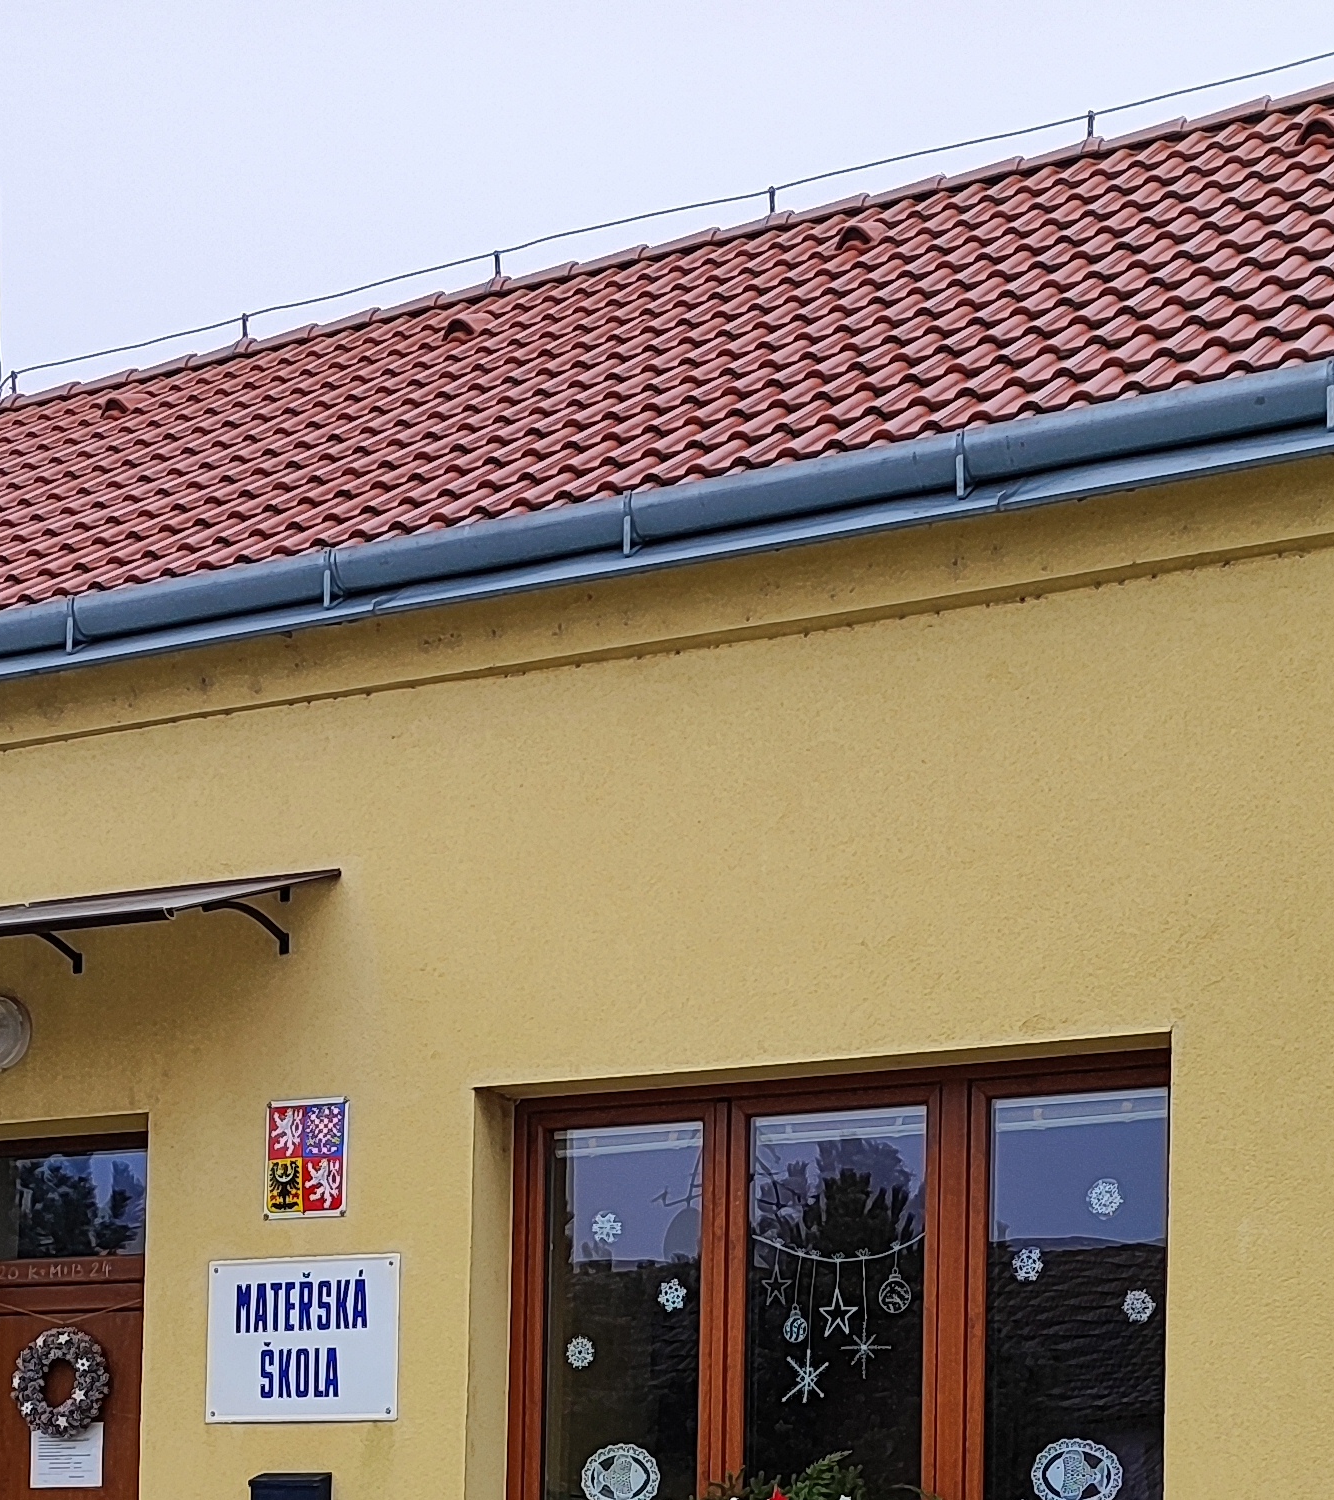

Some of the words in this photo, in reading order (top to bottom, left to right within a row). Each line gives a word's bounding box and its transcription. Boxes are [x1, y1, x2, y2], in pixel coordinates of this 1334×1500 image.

[89, 1261, 112, 1278] 24
[235, 1269, 368, 1333] MATEŘSKÁ
[260, 1341, 339, 1399] ŠKOLA
